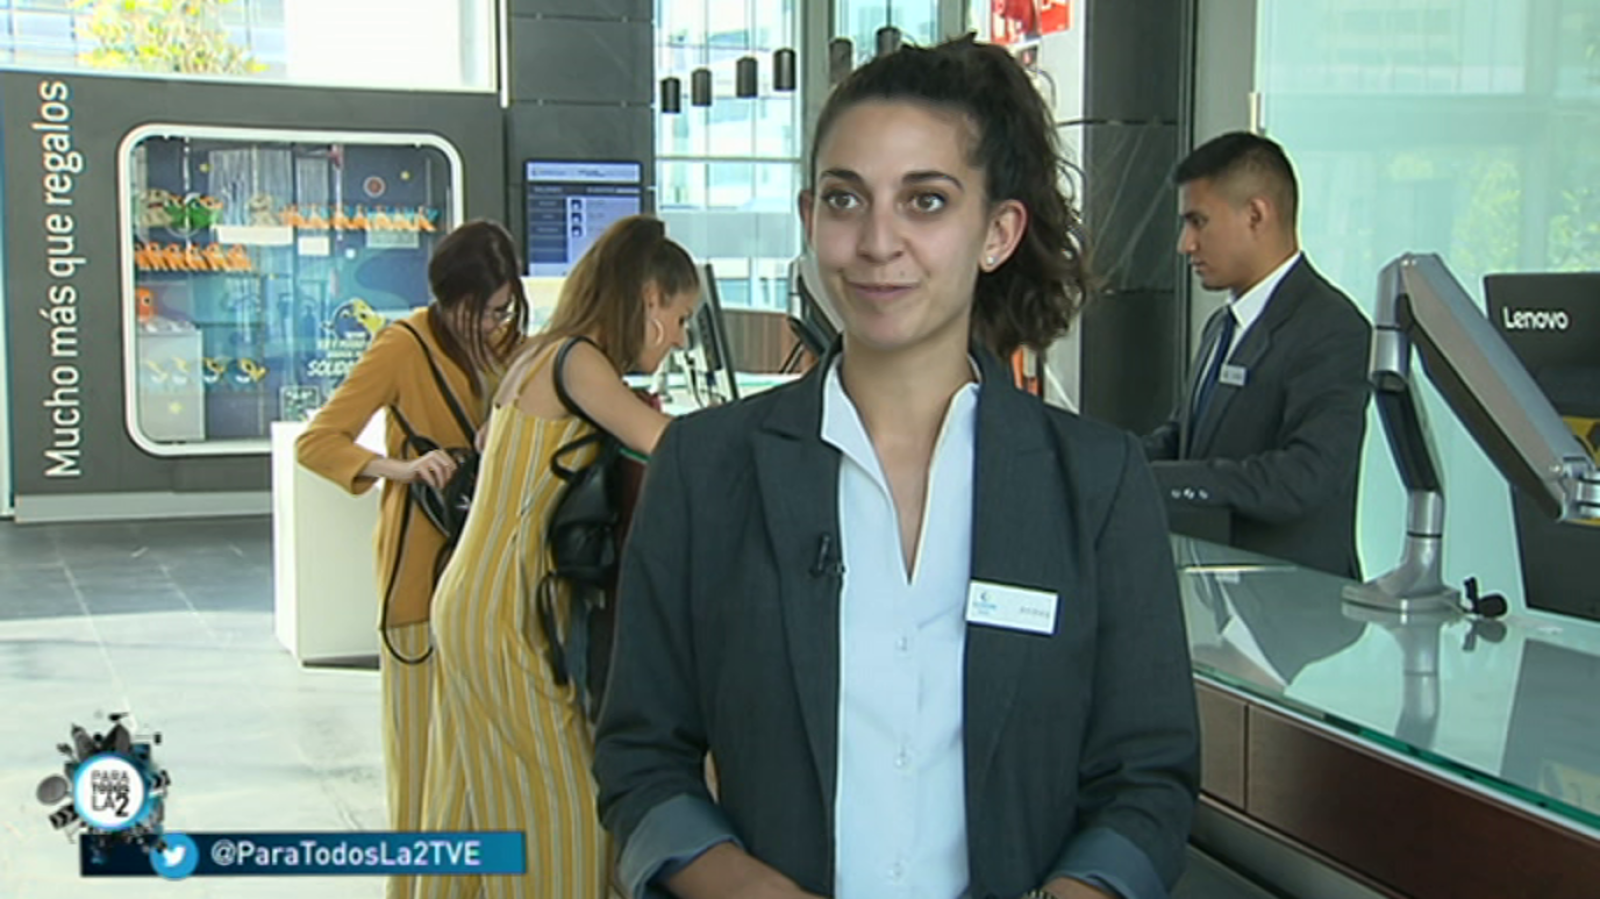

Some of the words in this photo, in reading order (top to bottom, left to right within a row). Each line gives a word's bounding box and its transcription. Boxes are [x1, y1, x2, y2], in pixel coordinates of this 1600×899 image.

[31, 81, 83, 205] regalos
[46, 214, 87, 277] que
[39, 286, 77, 357] más
[1503, 306, 1569, 329] Lenovo
[43, 366, 81, 476] Mucho
